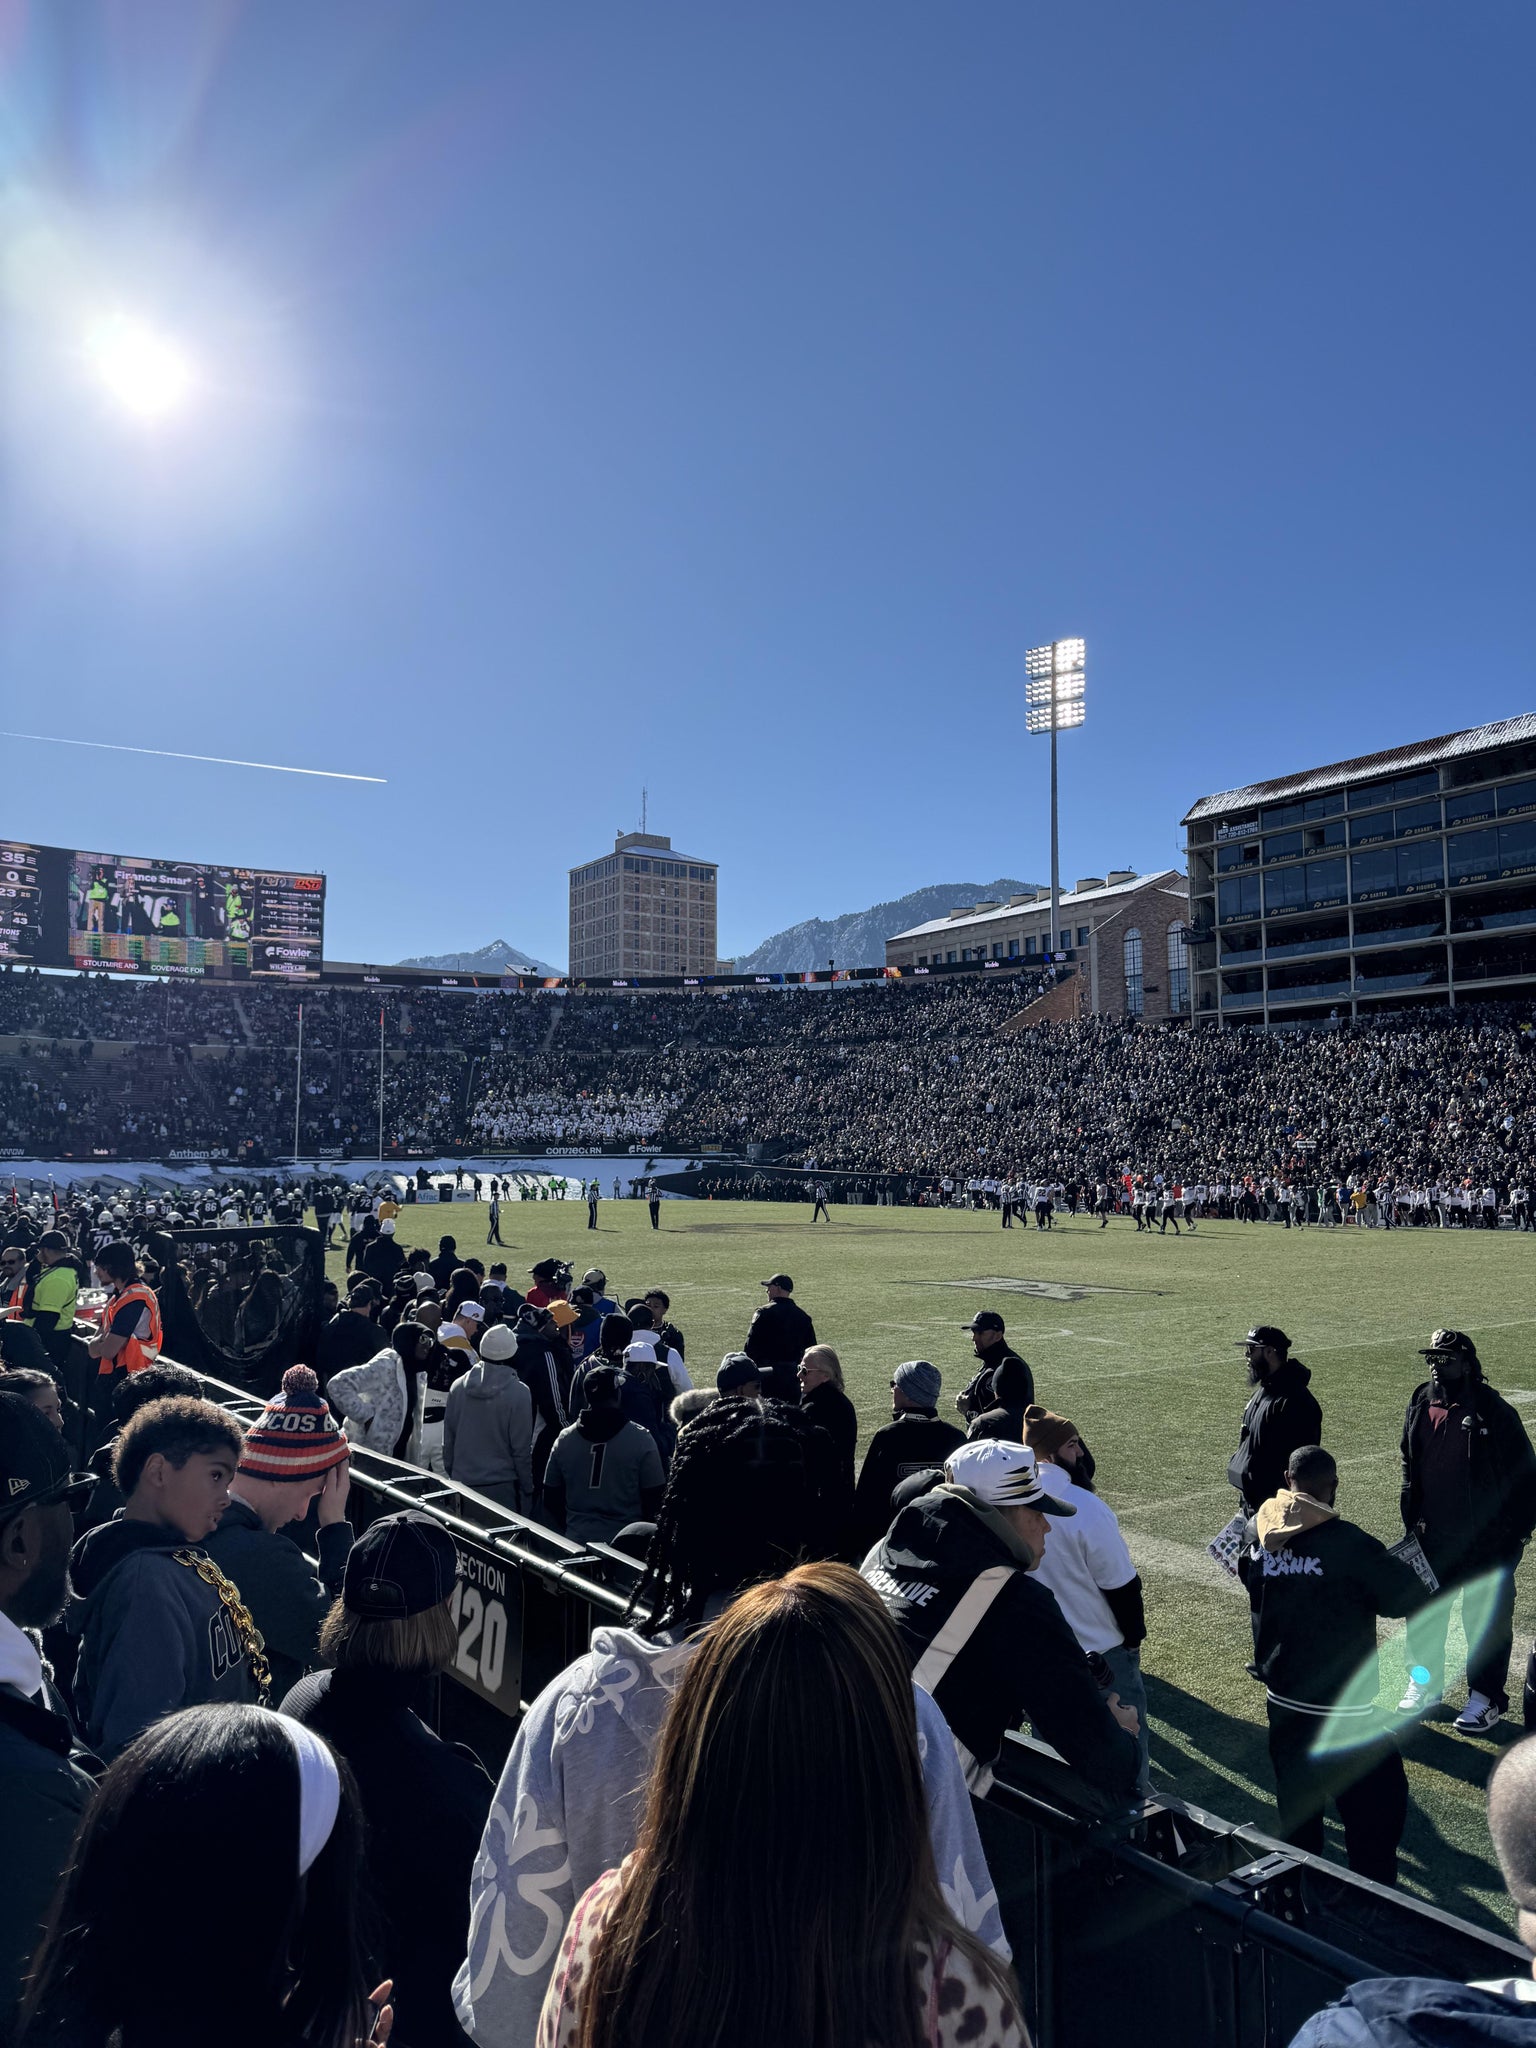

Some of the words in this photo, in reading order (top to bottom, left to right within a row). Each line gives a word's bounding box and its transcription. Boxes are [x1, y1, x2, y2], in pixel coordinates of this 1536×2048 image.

[1, 852, 25, 864] 35
[6, 871, 19, 882] 0
[114, 870, 158, 883] Finance
[12, 917, 28, 925] 43
[276, 947, 312, 957] Fowler
[124, 961, 139, 970] AND
[151, 964, 189, 974] COVERAGE
[168, 1149, 210, 1159] Anthem
[635, 1145, 662, 1153] Fowler
[204, 1203, 217, 1212] 86
[359, 1199, 372, 1207] 72
[589, 1442, 607, 1489] 1
[1263, 1556, 1324, 1577] RANK
[456, 1551, 506, 1597] ECTION
